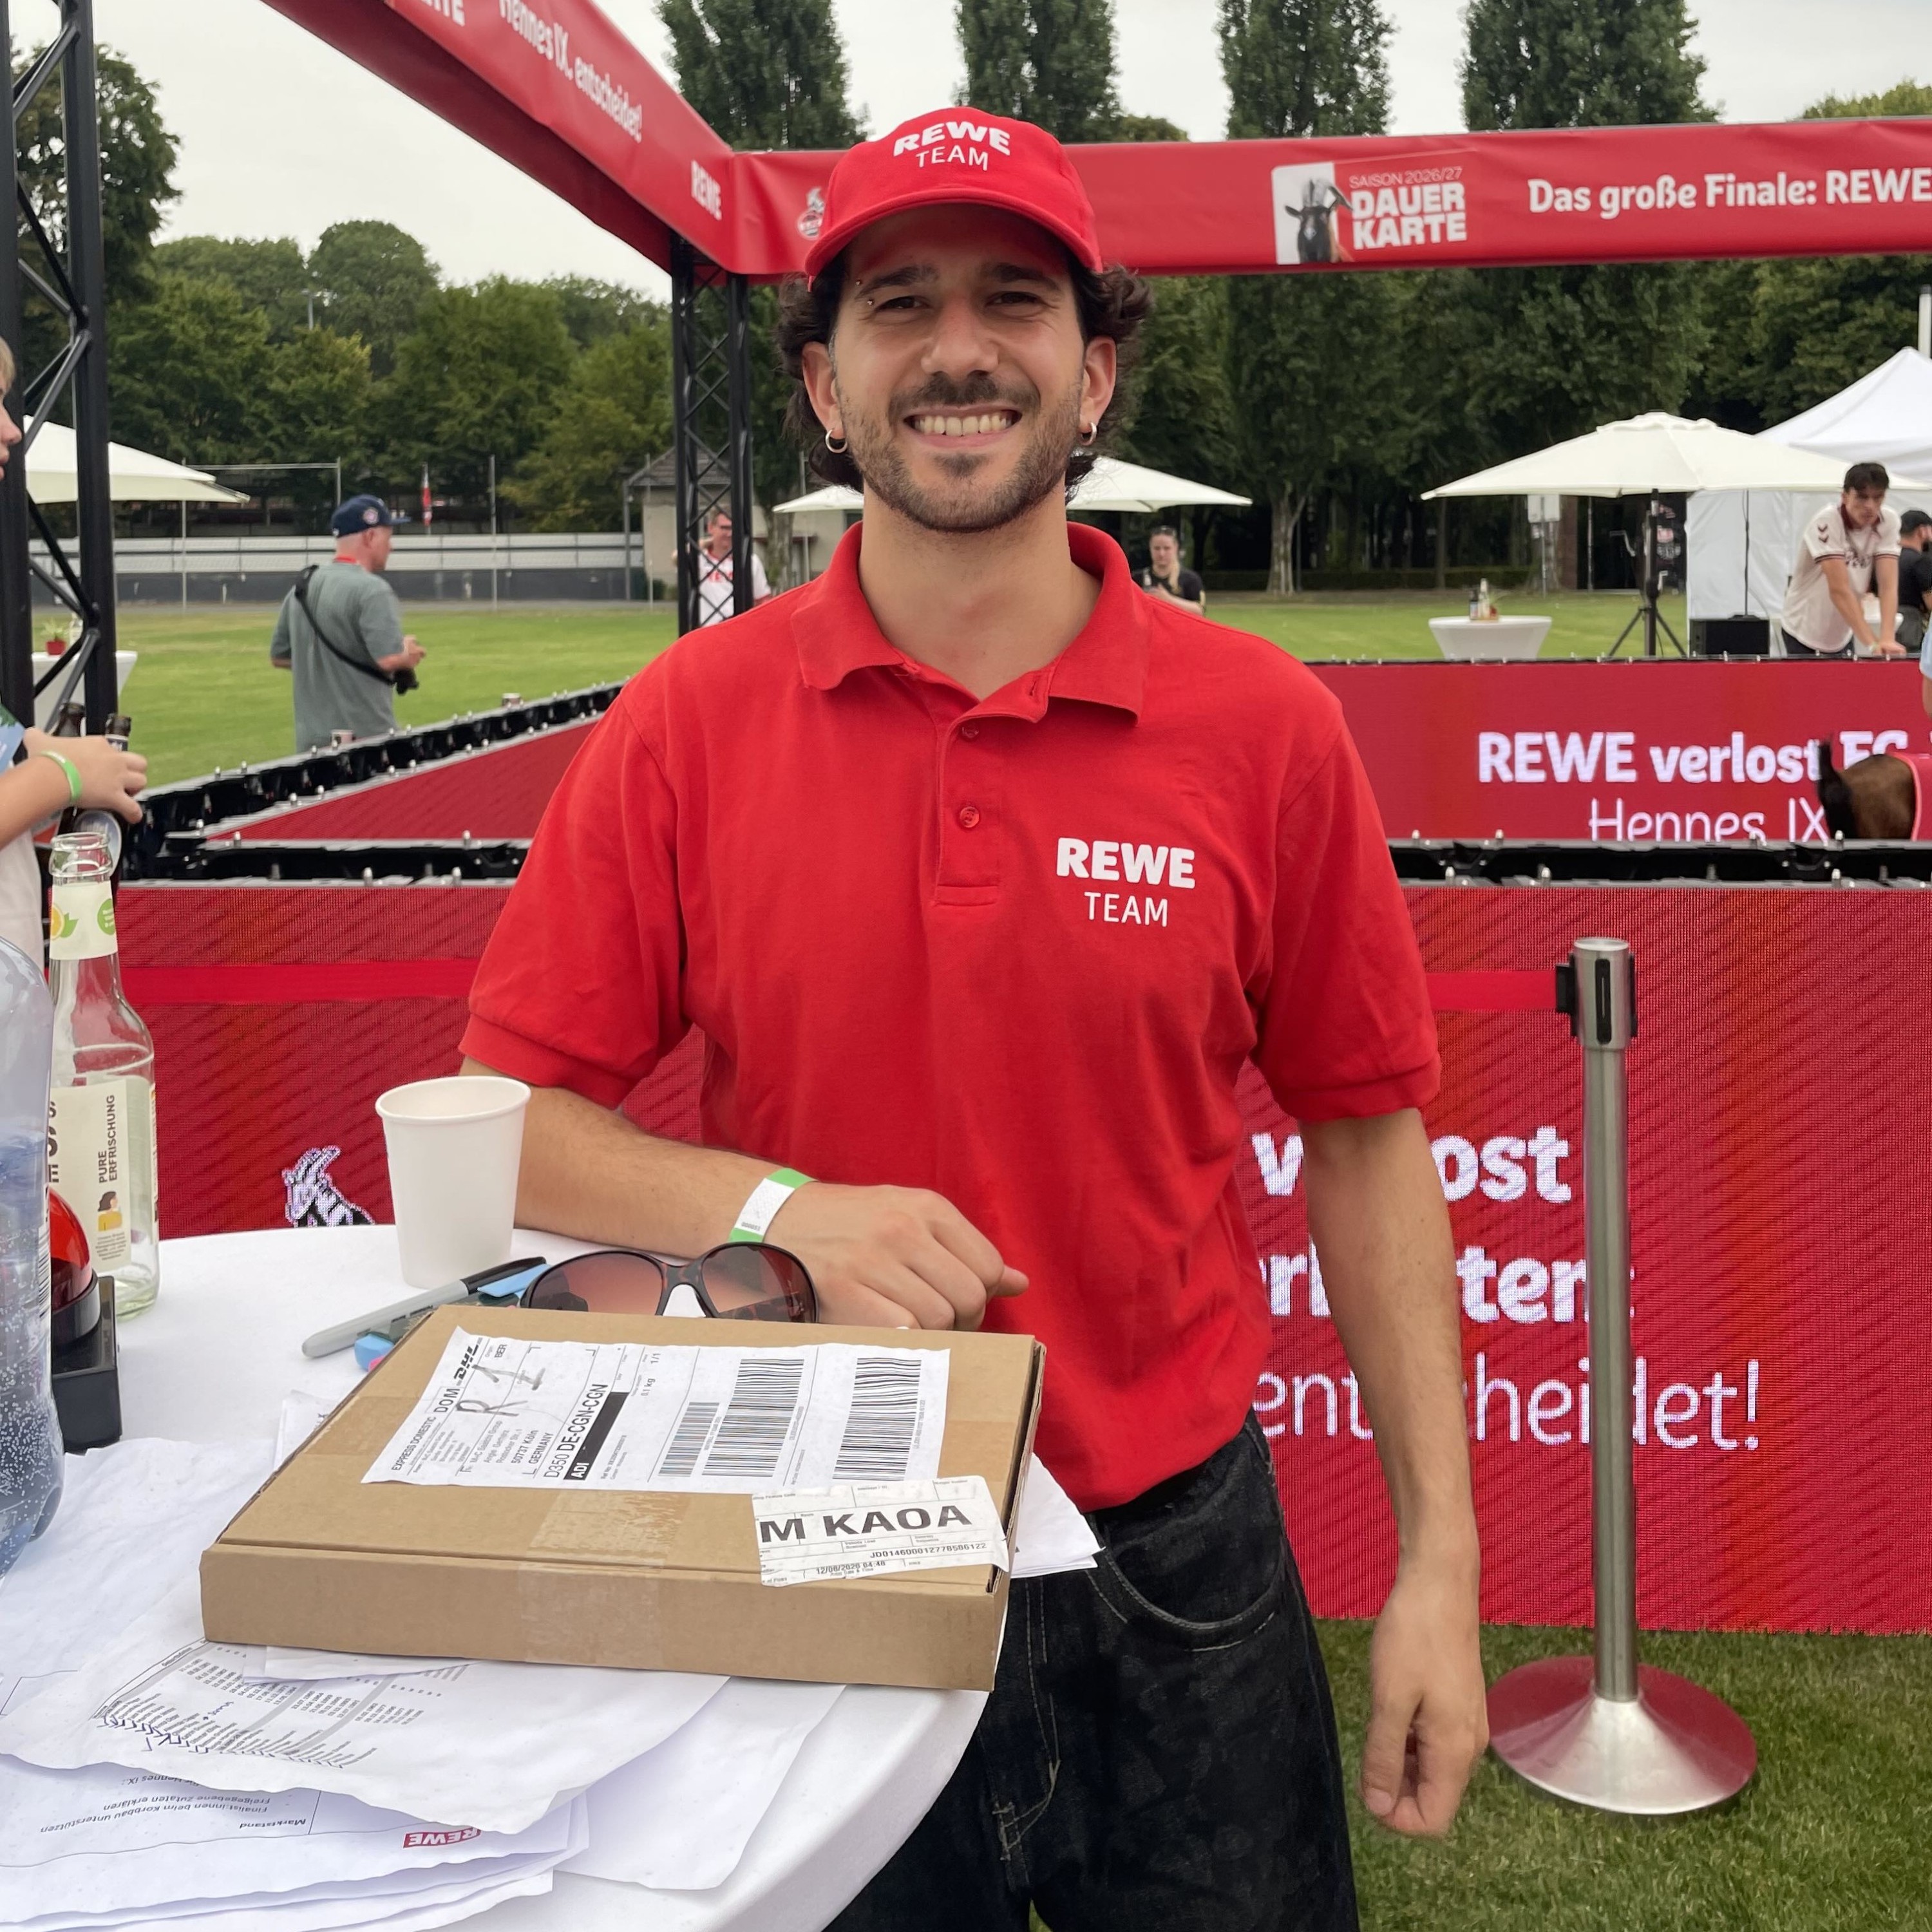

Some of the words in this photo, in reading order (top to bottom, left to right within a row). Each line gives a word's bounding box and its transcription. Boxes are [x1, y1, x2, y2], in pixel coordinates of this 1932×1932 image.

[893, 121, 1010, 156] REWE
[916, 145, 989, 171] TEAM
[1349, 173, 1402, 189] SAISON
[1405, 166, 1463, 185] 2026/27
[1528, 178, 1591, 213] Das
[1599, 174, 1696, 220] große
[1705, 171, 1817, 208] Finale:
[1825, 167, 1932, 205] REWE
[1351, 182, 1465, 220] DAUER
[1353, 211, 1467, 251] KARTE
[1479, 731, 1636, 783] REWE
[1649, 730, 1823, 784] verlost
[1589, 798, 1765, 842] Hennes
[1057, 837, 1195, 889] REWE
[1084, 891, 1168, 927] TEAM
[106, 1095, 117, 1182] ERFRISCHUNG
[99, 1150, 108, 1184] PURE
[452, 1344, 480, 1379] DHL
[493, 1344, 508, 1358] BER
[650, 1352, 661, 1363] 1/1
[644, 1378, 656, 1387] kg
[433, 1388, 461, 1412] DOM
[556, 1383, 608, 1450] DE-CGN-CGN
[390, 1444, 417, 1470] EXPRESS
[410, 1416, 437, 1443] DOMESTIC
[511, 1446, 529, 1463] 50737
[522, 1430, 538, 1443] Köln
[527, 1432, 553, 1463] GERMANY
[543, 1454, 570, 1477] D350
[570, 1463, 589, 1477] ADI
[760, 1519, 806, 1543] M
[822, 1505, 972, 1537] KAOA
[103, 1796, 148, 1810] erklären
[115, 1805, 160, 1819] Korbbau
[151, 1794, 193, 1803] Zutaten
[40, 1814, 112, 1833] unterstützen
[239, 1819, 307, 1830] Marktstand
[408, 1829, 477, 1846] REWE
